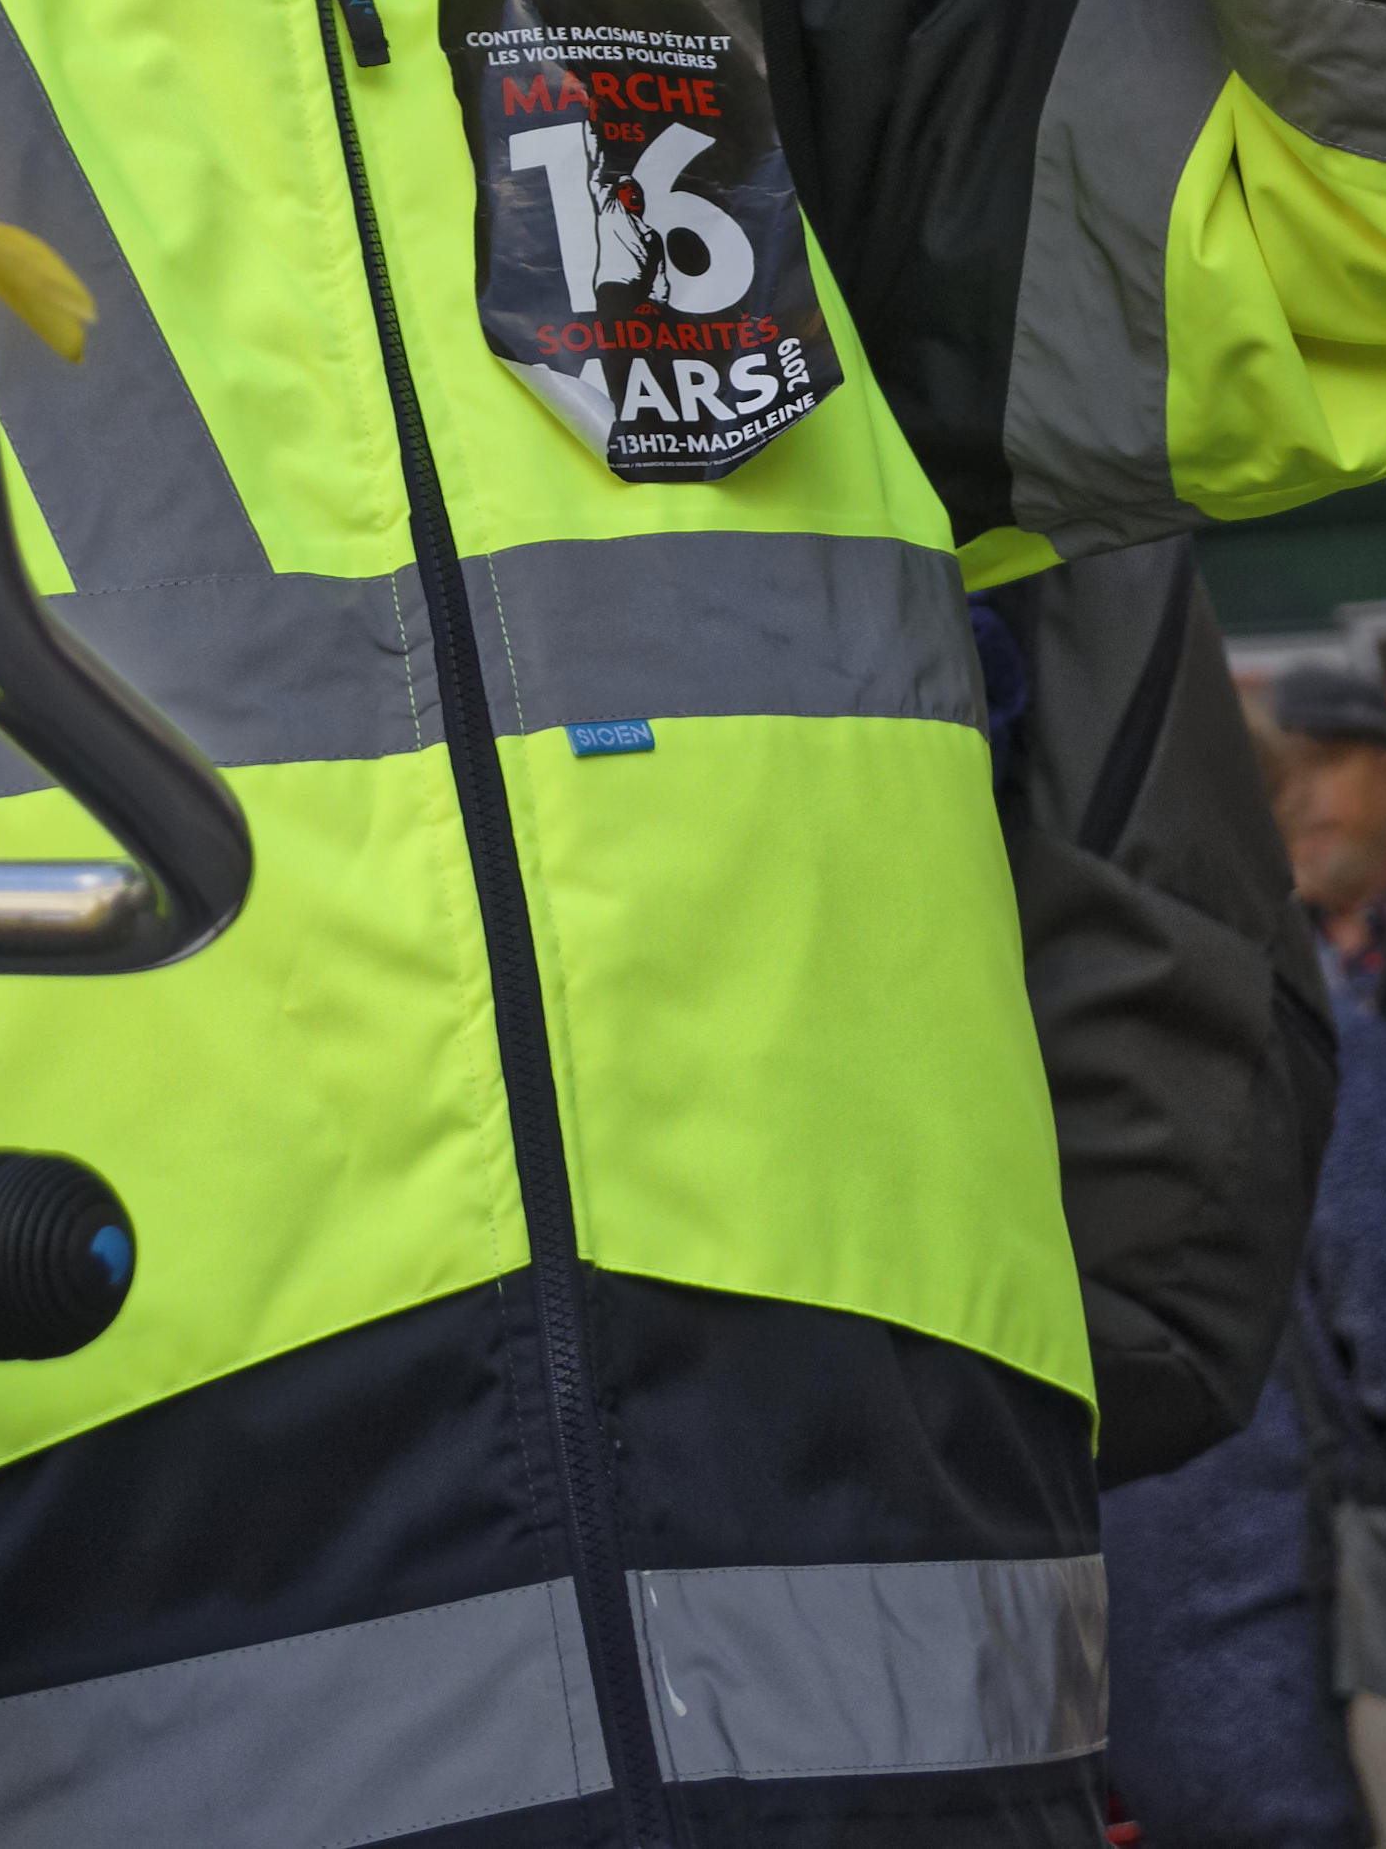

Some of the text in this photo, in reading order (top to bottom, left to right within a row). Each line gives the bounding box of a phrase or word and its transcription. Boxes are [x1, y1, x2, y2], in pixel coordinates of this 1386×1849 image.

[466, 26, 731, 51] CONTRE LE RACISME D'ÉTAT ET
[488, 45, 717, 70] LES VIOLENCES POLICIÈRES
[502, 69, 722, 117] MARCHE
[603, 122, 646, 142] DES
[509, 120, 754, 314] 16
[537, 312, 779, 355] SOLIDARITÉS
[777, 337, 811, 393] 2019
